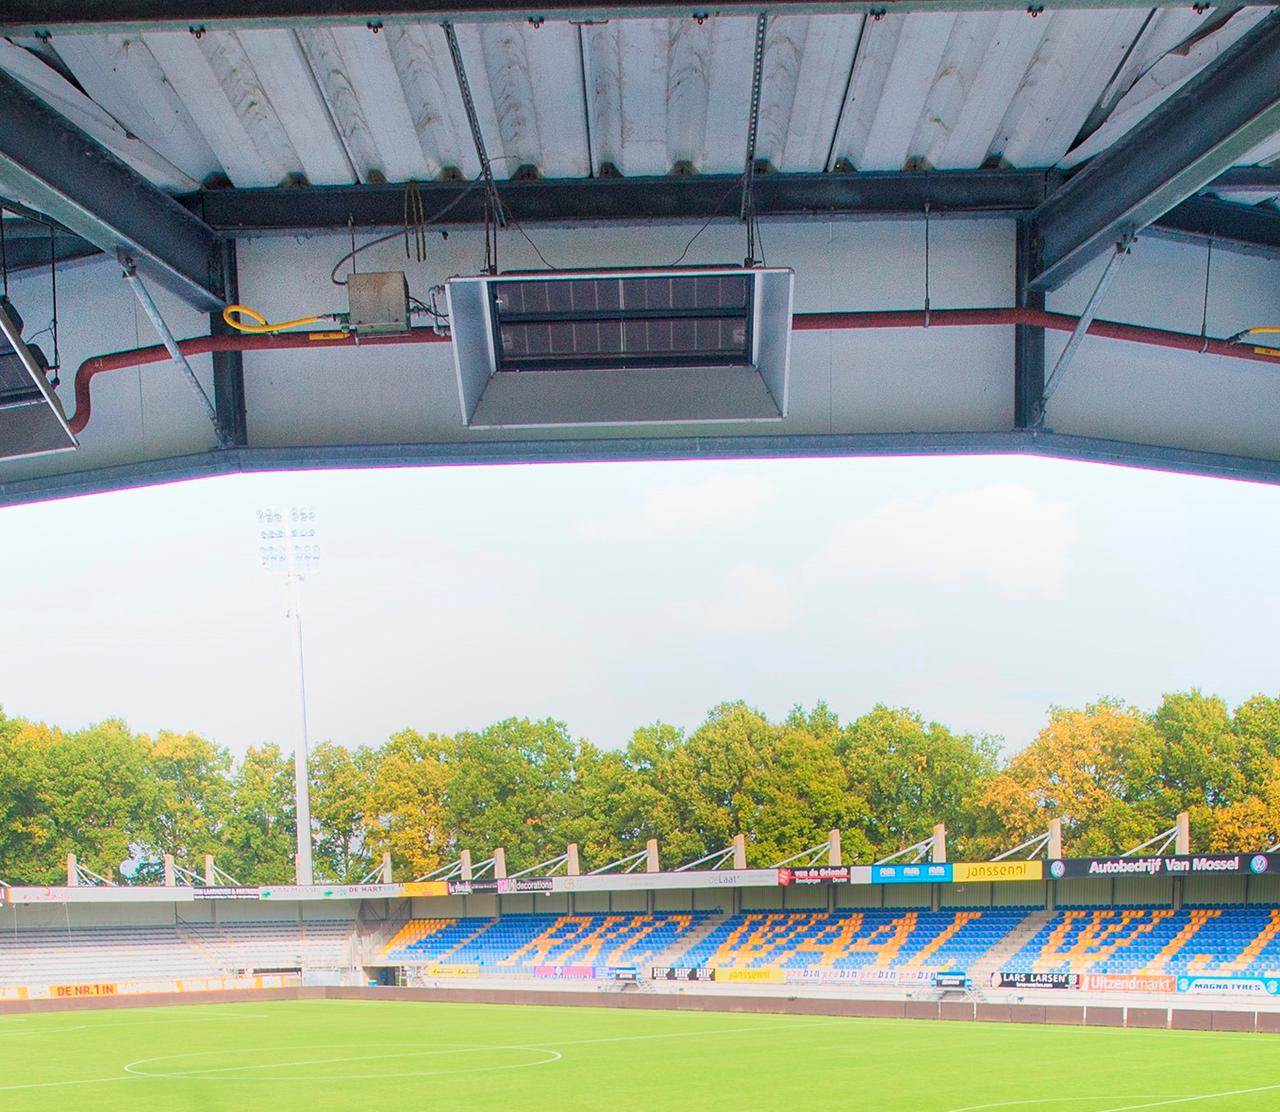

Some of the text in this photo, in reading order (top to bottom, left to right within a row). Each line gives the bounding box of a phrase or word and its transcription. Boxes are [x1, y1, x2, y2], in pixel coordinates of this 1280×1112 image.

[1089, 857, 1238, 874] Autobedrijf Van Mossel
[1004, 974, 1066, 983] LARS LARSEN
[1090, 975, 1172, 991] Uitzendmarkt
[57, 987, 72, 998] DE
